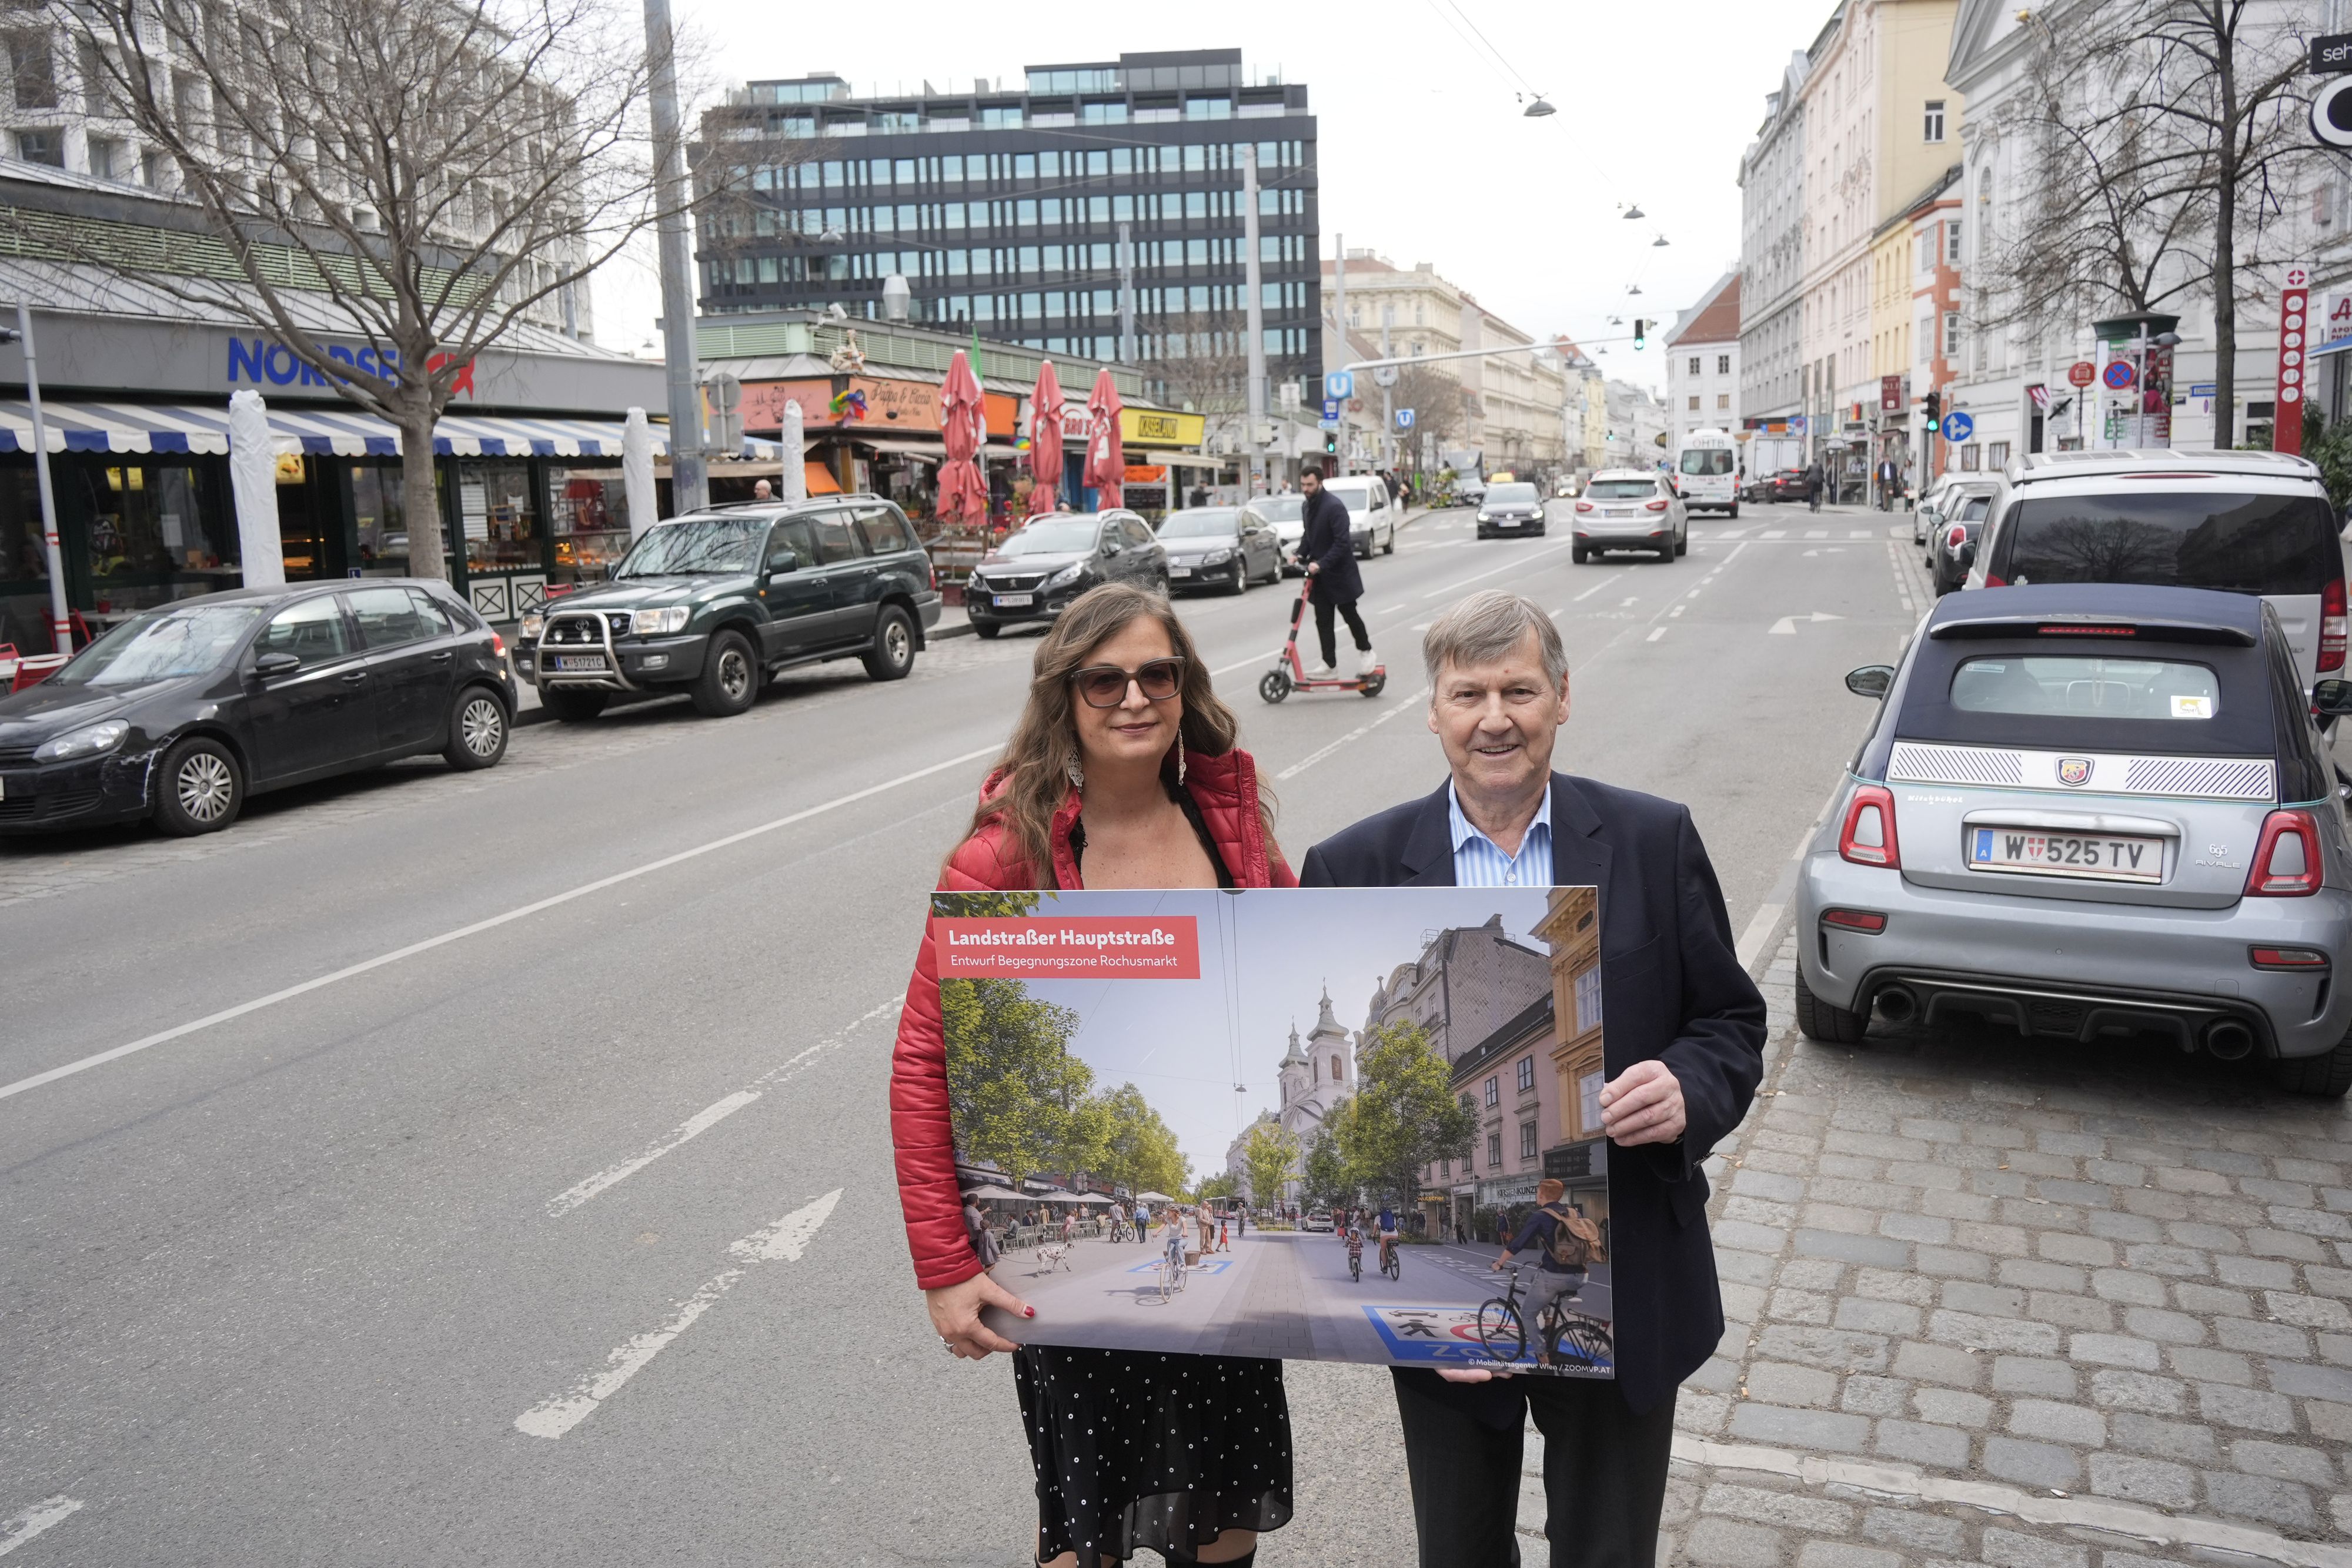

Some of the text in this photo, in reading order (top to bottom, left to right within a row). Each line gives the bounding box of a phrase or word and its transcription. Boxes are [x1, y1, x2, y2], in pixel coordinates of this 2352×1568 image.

[228, 337, 404, 387] NORDSE
[1329, 376, 1348, 396] U
[1399, 412, 1411, 426] U
[1980, 849, 1988, 858] A
[2006, 835, 2143, 868] W 525 TV
[2209, 844, 2227, 858] 695
[949, 928, 1175, 950] Landstraßer Hauptstraße
[951, 955, 1178, 969] Entwurf Begegnungszone Rochusmarkt
[1476, 1359, 1538, 1369] Mobilitätsagentur
[1565, 1364, 1611, 1374] ZOOMVP.AT
